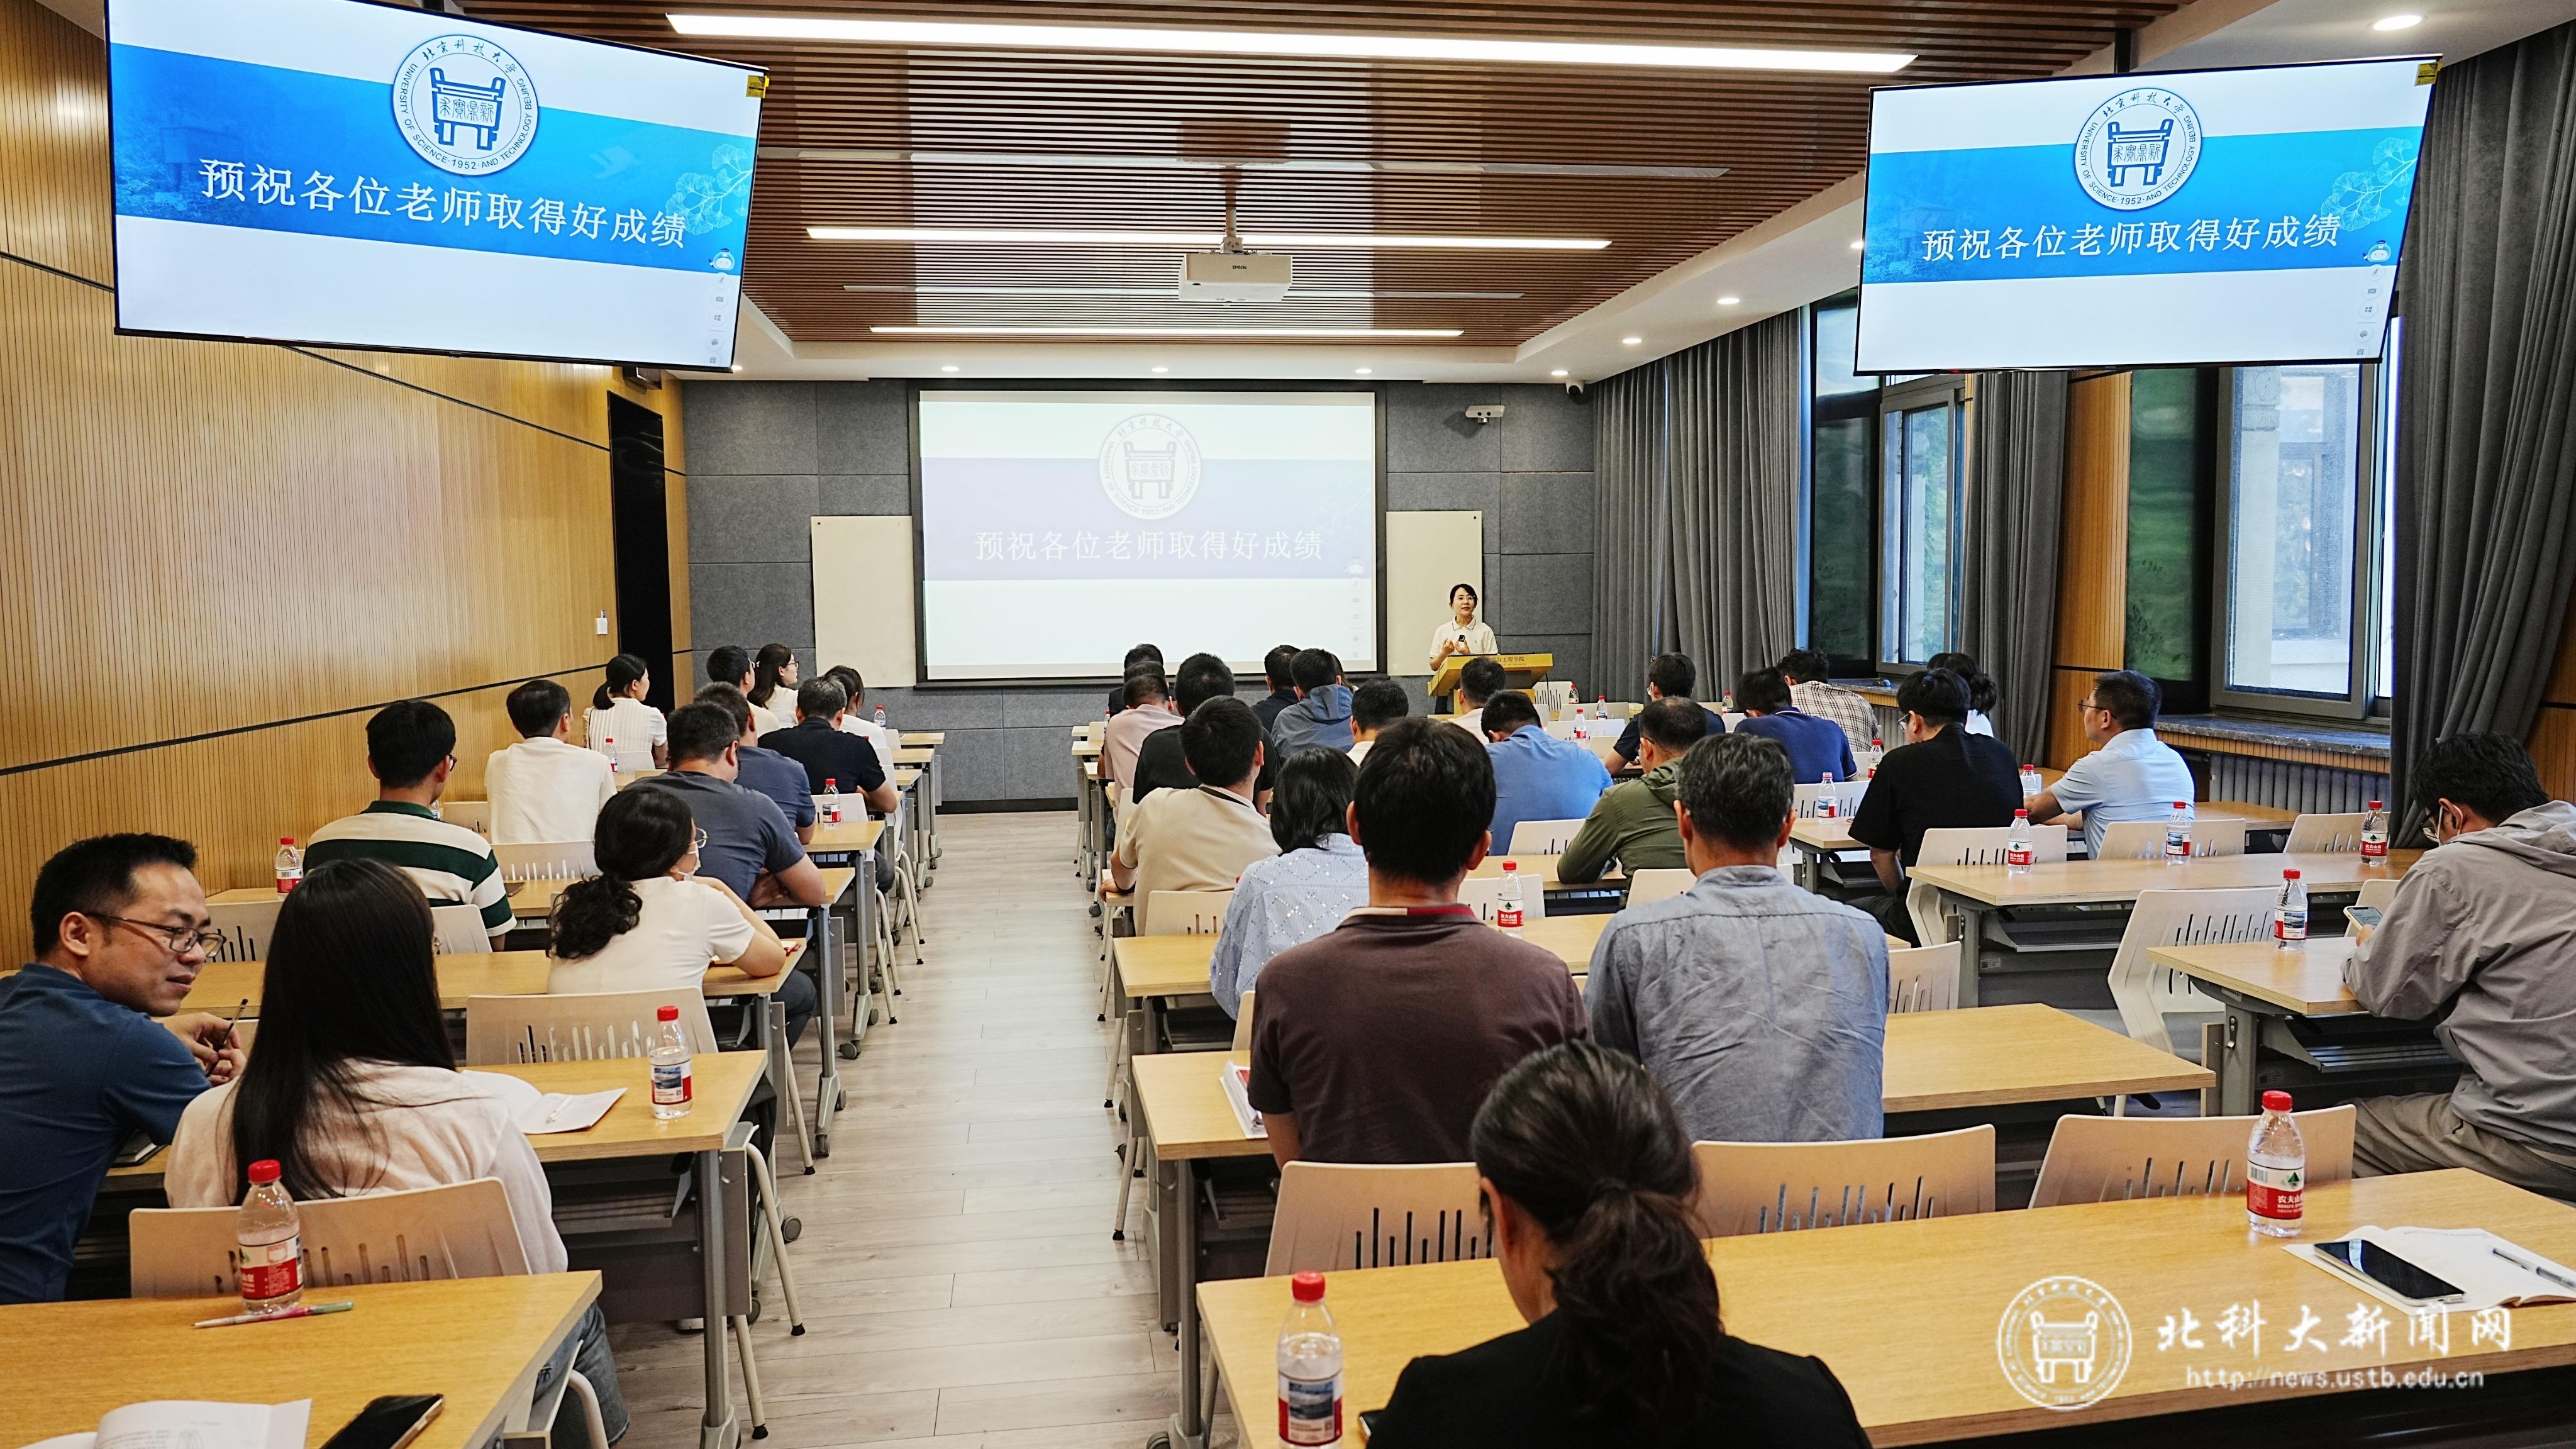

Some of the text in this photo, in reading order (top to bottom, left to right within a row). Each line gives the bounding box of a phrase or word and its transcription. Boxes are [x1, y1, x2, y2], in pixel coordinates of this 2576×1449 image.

[399, 63, 418, 114] UNIVERSITY
[517, 78, 532, 110] BEIJING
[404, 119, 415, 131] OF
[501, 114, 532, 161] TECHNOLOGY
[2184, 115, 2196, 143] BEIJING
[413, 134, 448, 163] SCIENCE
[2080, 122, 2098, 167] UNIVERSITY
[481, 158, 499, 169] AND
[2083, 170, 2092, 180] OF
[2164, 145, 2195, 192] TECHNOLOGY
[199, 157, 687, 249] 预祝各位老师取得好成绩
[2089, 181, 2118, 203] SCIENCE
[2146, 191, 2162, 201] AND
[1921, 213, 2341, 263] 预祝各位老师取得好成绩
[974, 530, 1323, 562] 预祝各位老师取得好成绩
